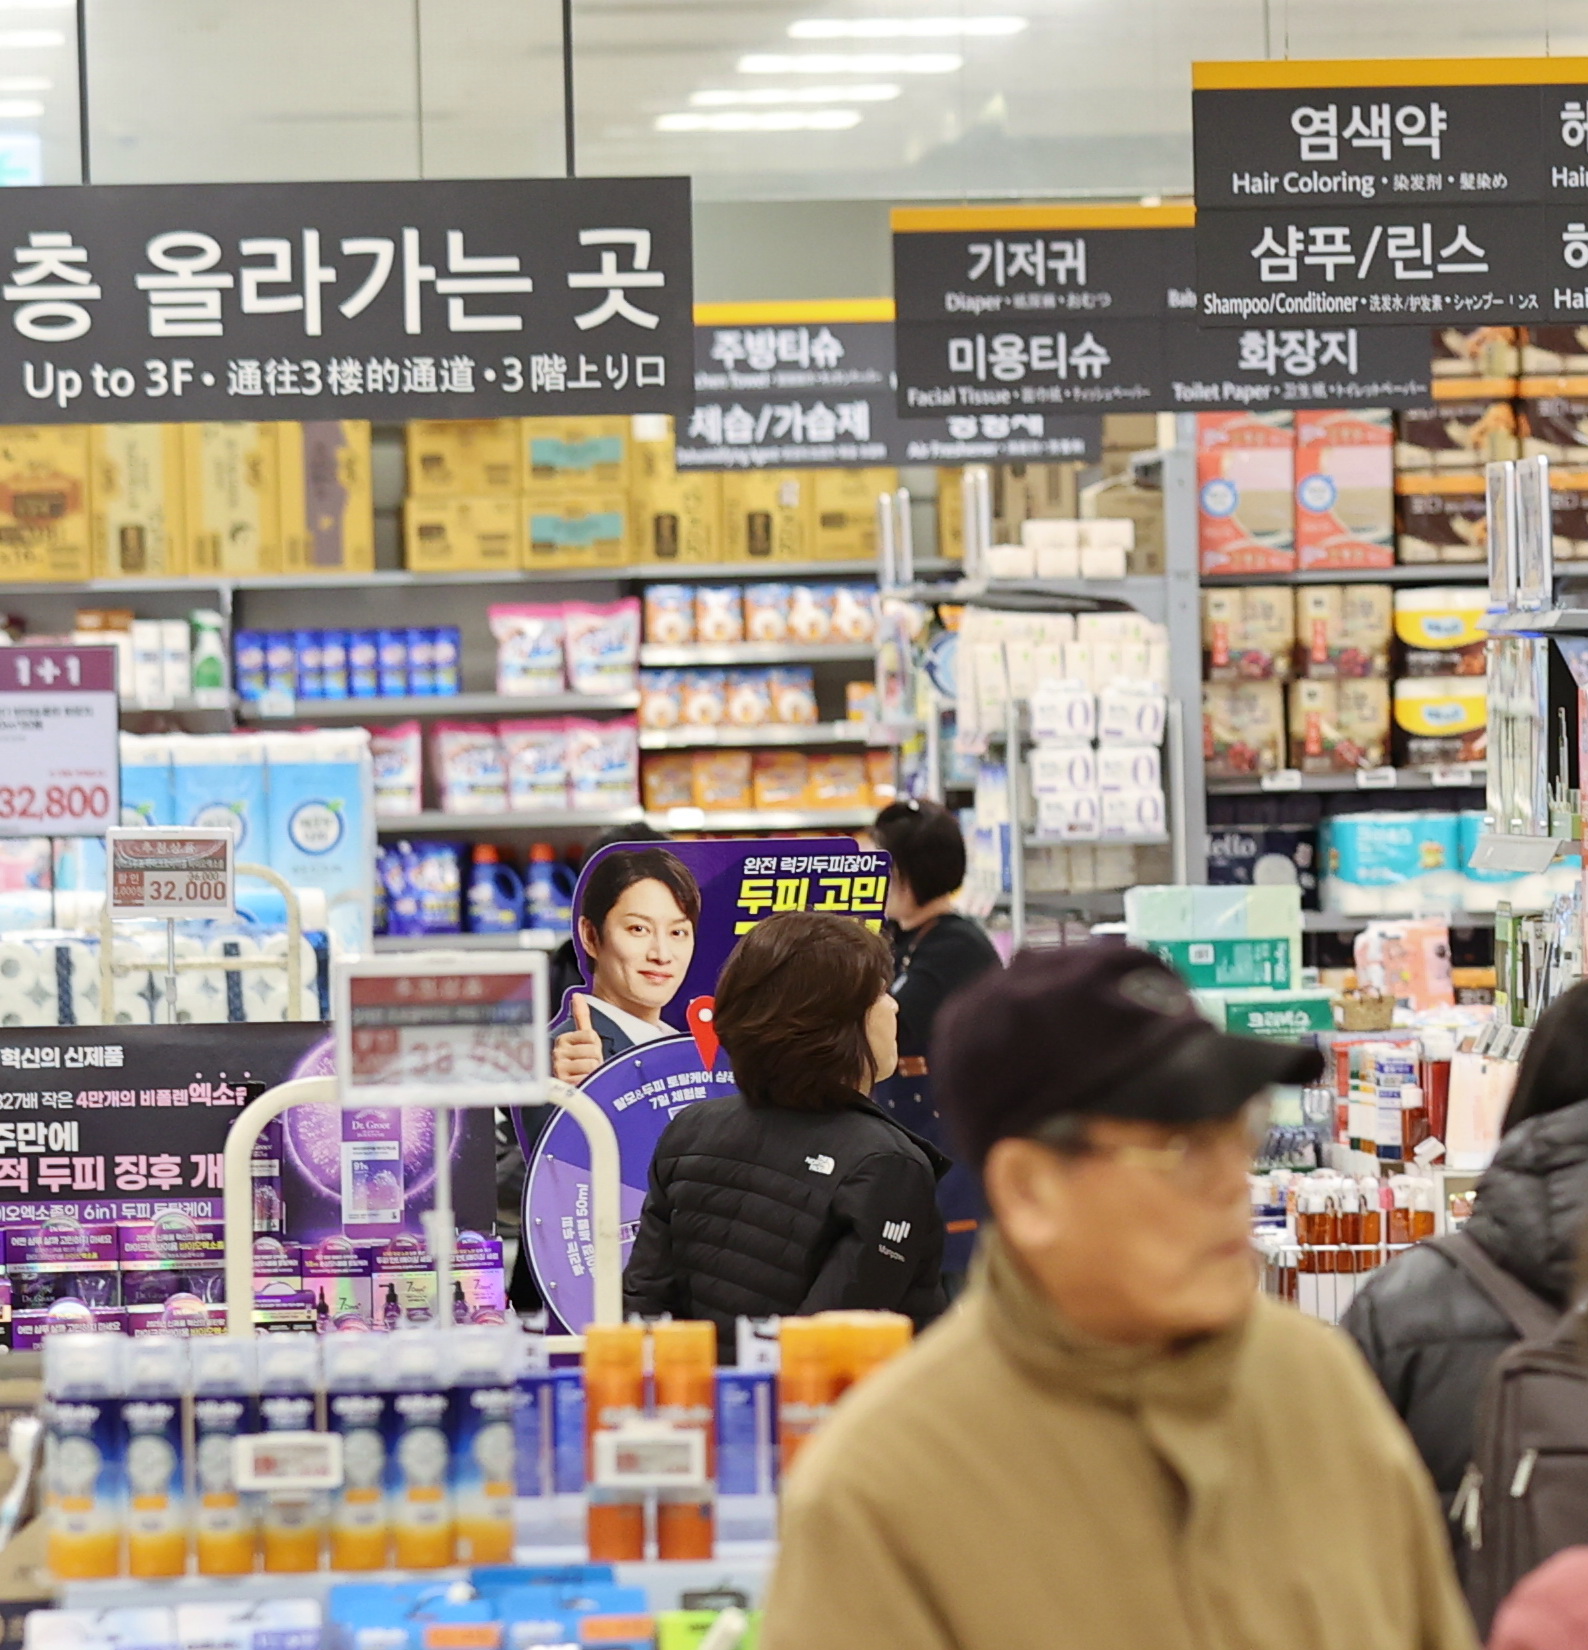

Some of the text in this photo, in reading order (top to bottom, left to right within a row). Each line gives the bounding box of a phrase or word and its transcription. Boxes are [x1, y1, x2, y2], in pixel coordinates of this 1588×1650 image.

[1291, 103, 1447, 161] 염색약
[1233, 172, 1375, 197] Hair Coloring
[967, 238, 1086, 287] 기저귀
[1251, 223, 1488, 282] 샴푸/린스
[2, 227, 665, 341] 층 올라가는 곳
[1204, 293, 1358, 319] Shampoo/Conditioner
[711, 326, 844, 371] 주방티슈
[948, 332, 1111, 382] 미용티슈
[1239, 329, 1357, 376] 화장지
[24, 361, 194, 407] Up to 3F
[227, 359, 476, 396] 通往3楼的通道
[503, 354, 665, 390] 3階上り口
[908, 387, 956, 407] Facial
[960, 386, 1011, 405] Tissue
[1173, 381, 1271, 405] Toilet Paper
[688, 400, 870, 445] 제습/가습제
[16, 655, 81, 686] 1+1
[0, 786, 109, 821] 32,800
[744, 855, 886, 874] 완전 럭키두피잖아~
[737, 876, 888, 914] 두피 고민
[1, 1046, 124, 1069] 혁신의 신제품
[667, 1072, 713, 1090] 토탈케어
[41, 1091, 74, 1109] 작은
[76, 1090, 135, 1108] 4만개의
[649, 1095, 670, 1110] 7일
[38, 1156, 105, 1193] 두피
[114, 1153, 183, 1191] 징후
[84, 1203, 118, 1219] 6in1
[121, 1203, 150, 1218] 두피
[576, 1183, 589, 1217] 50ml
